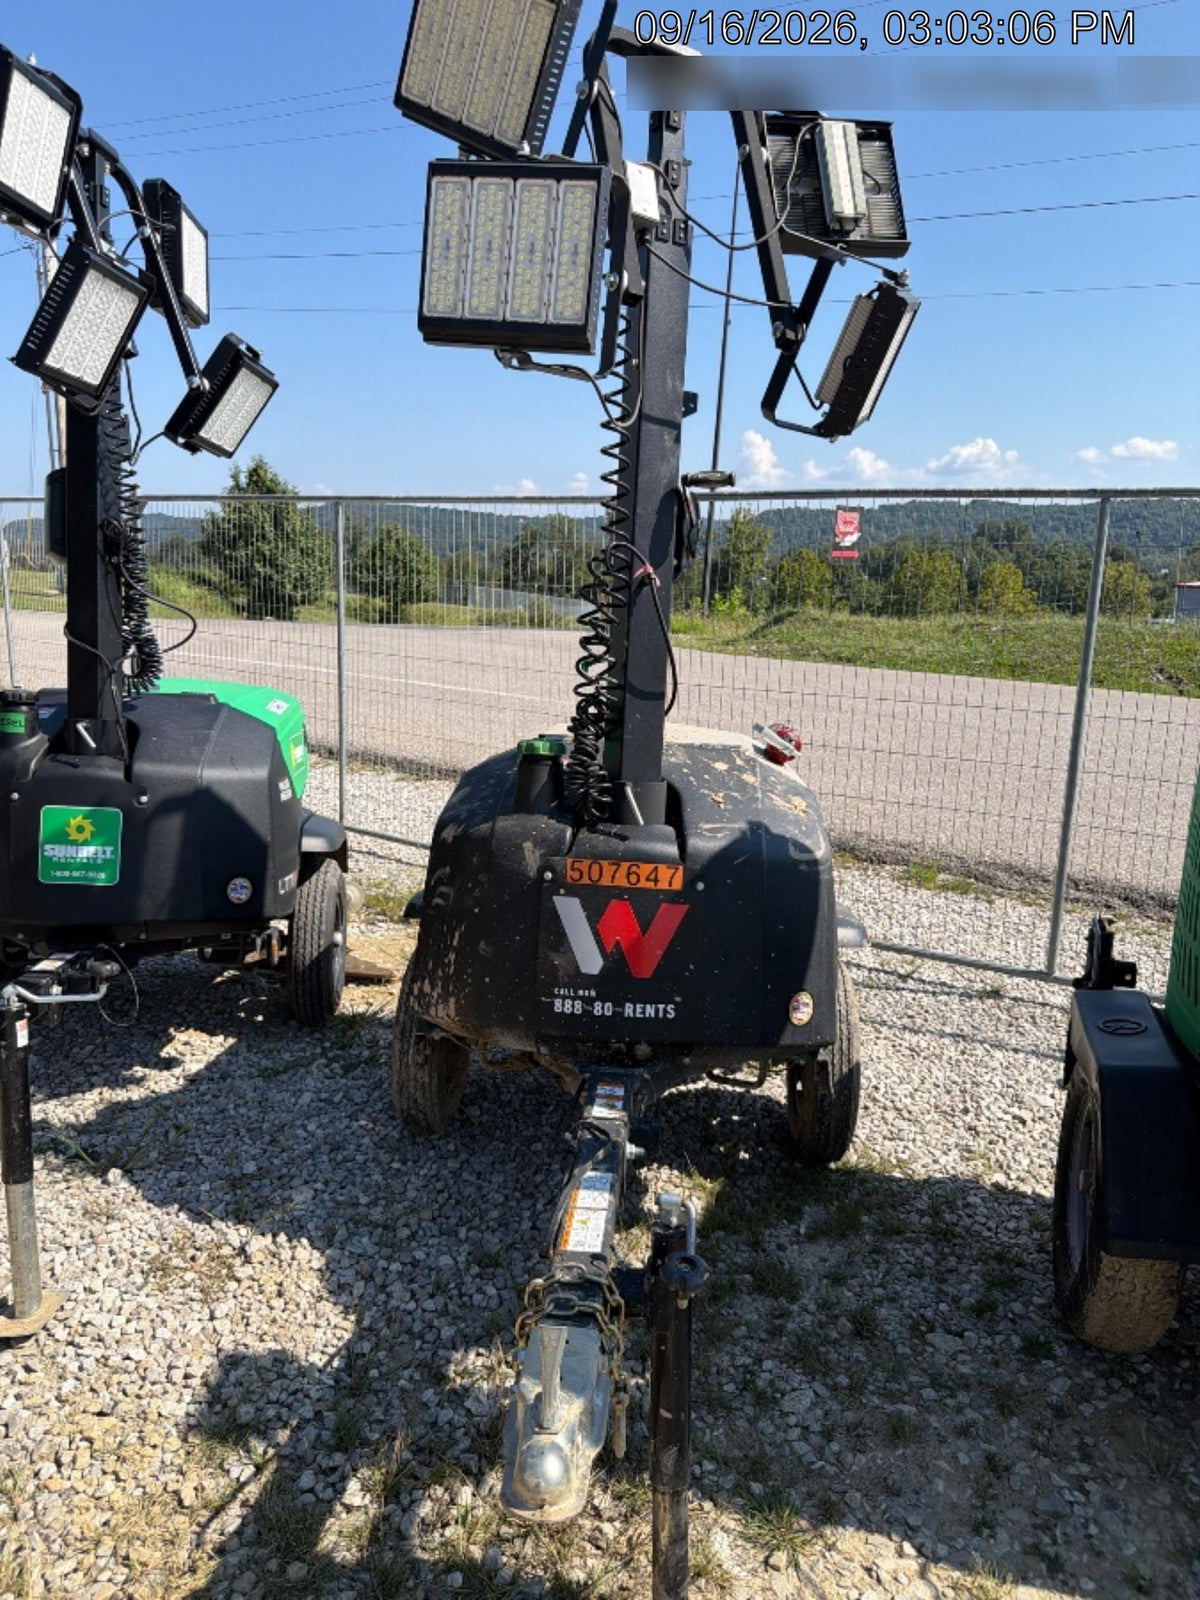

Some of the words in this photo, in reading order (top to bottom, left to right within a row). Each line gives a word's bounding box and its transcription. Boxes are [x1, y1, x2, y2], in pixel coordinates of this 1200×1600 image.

[43, 844, 114, 859] SUNBELT
[569, 860, 681, 888] 507647
[554, 987, 576, 996] CALL
